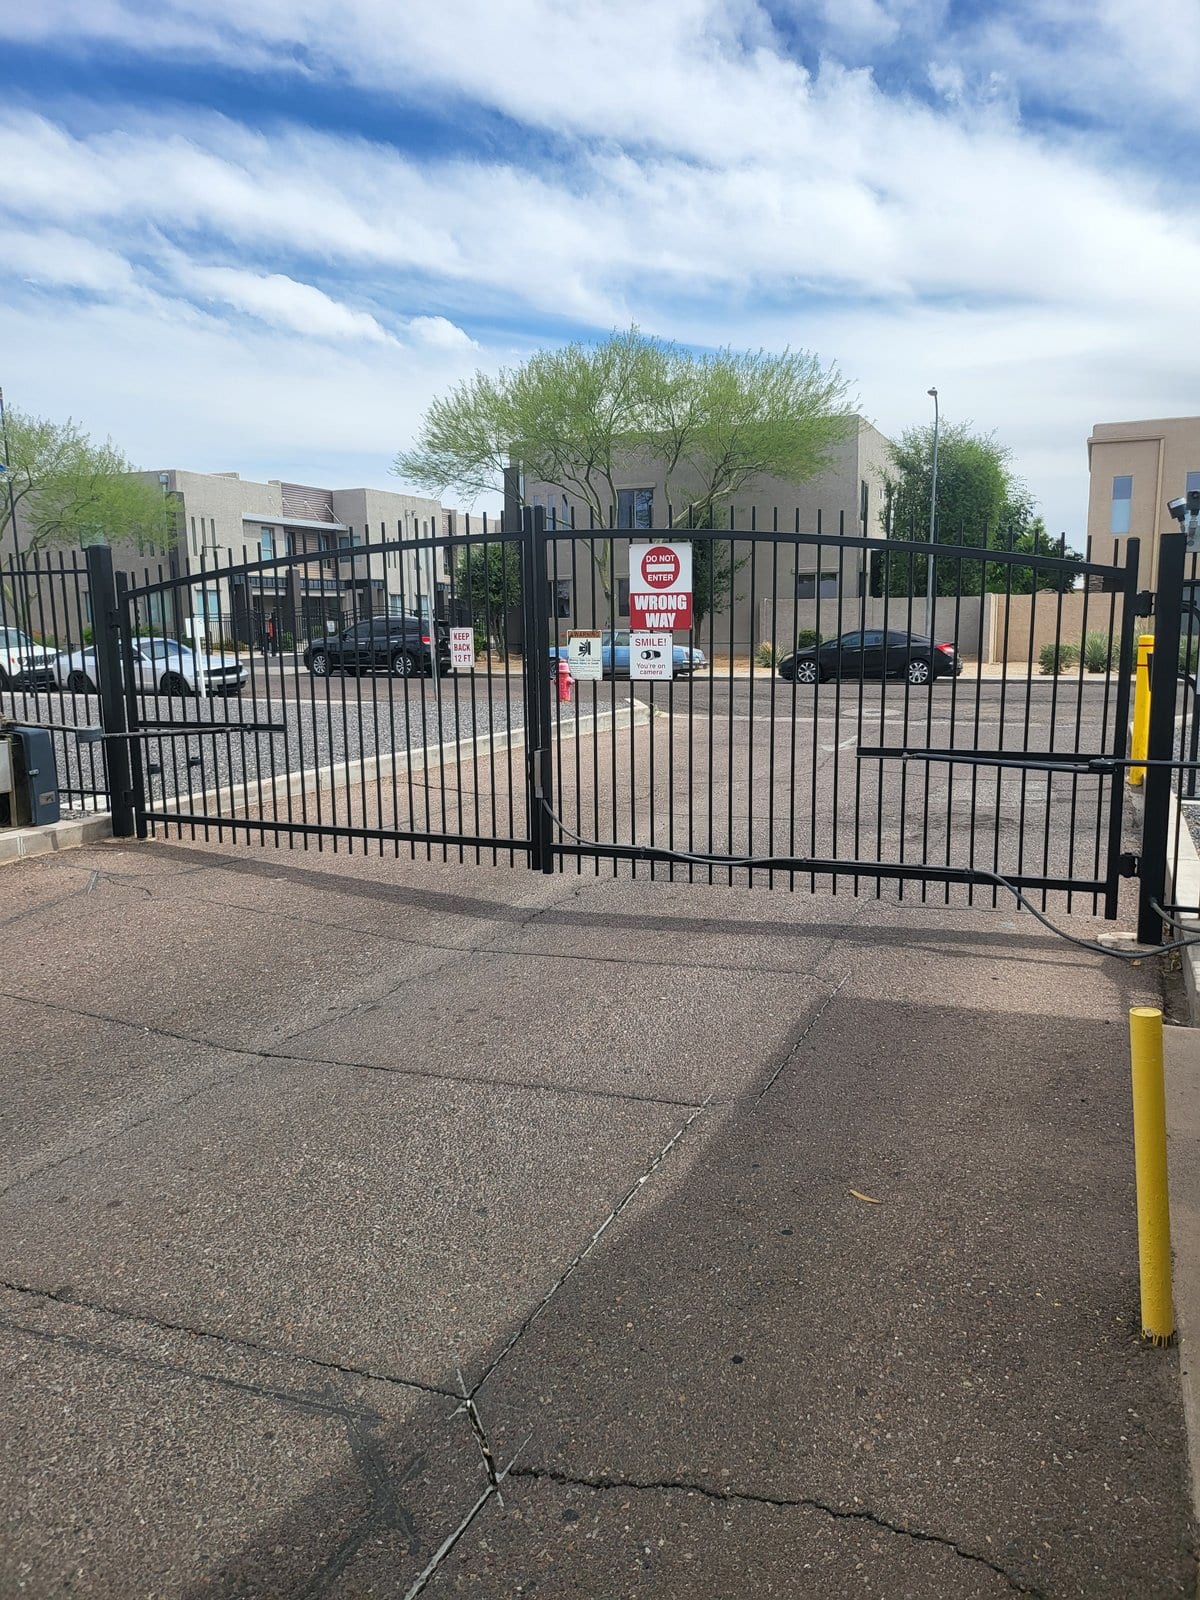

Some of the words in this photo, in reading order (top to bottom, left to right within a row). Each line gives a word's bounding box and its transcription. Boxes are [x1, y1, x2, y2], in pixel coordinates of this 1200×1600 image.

[646, 555, 657, 563] DO
[659, 554, 675, 562] NOT
[647, 574, 674, 582] ENTER
[634, 594, 687, 611] WRONG
[645, 612, 676, 628] WAY
[453, 632, 470, 641] KEEP
[453, 643, 471, 651] BACK
[635, 638, 667, 647] SMILE!
[454, 654, 462, 662] 12
[463, 654, 471, 662] FT
